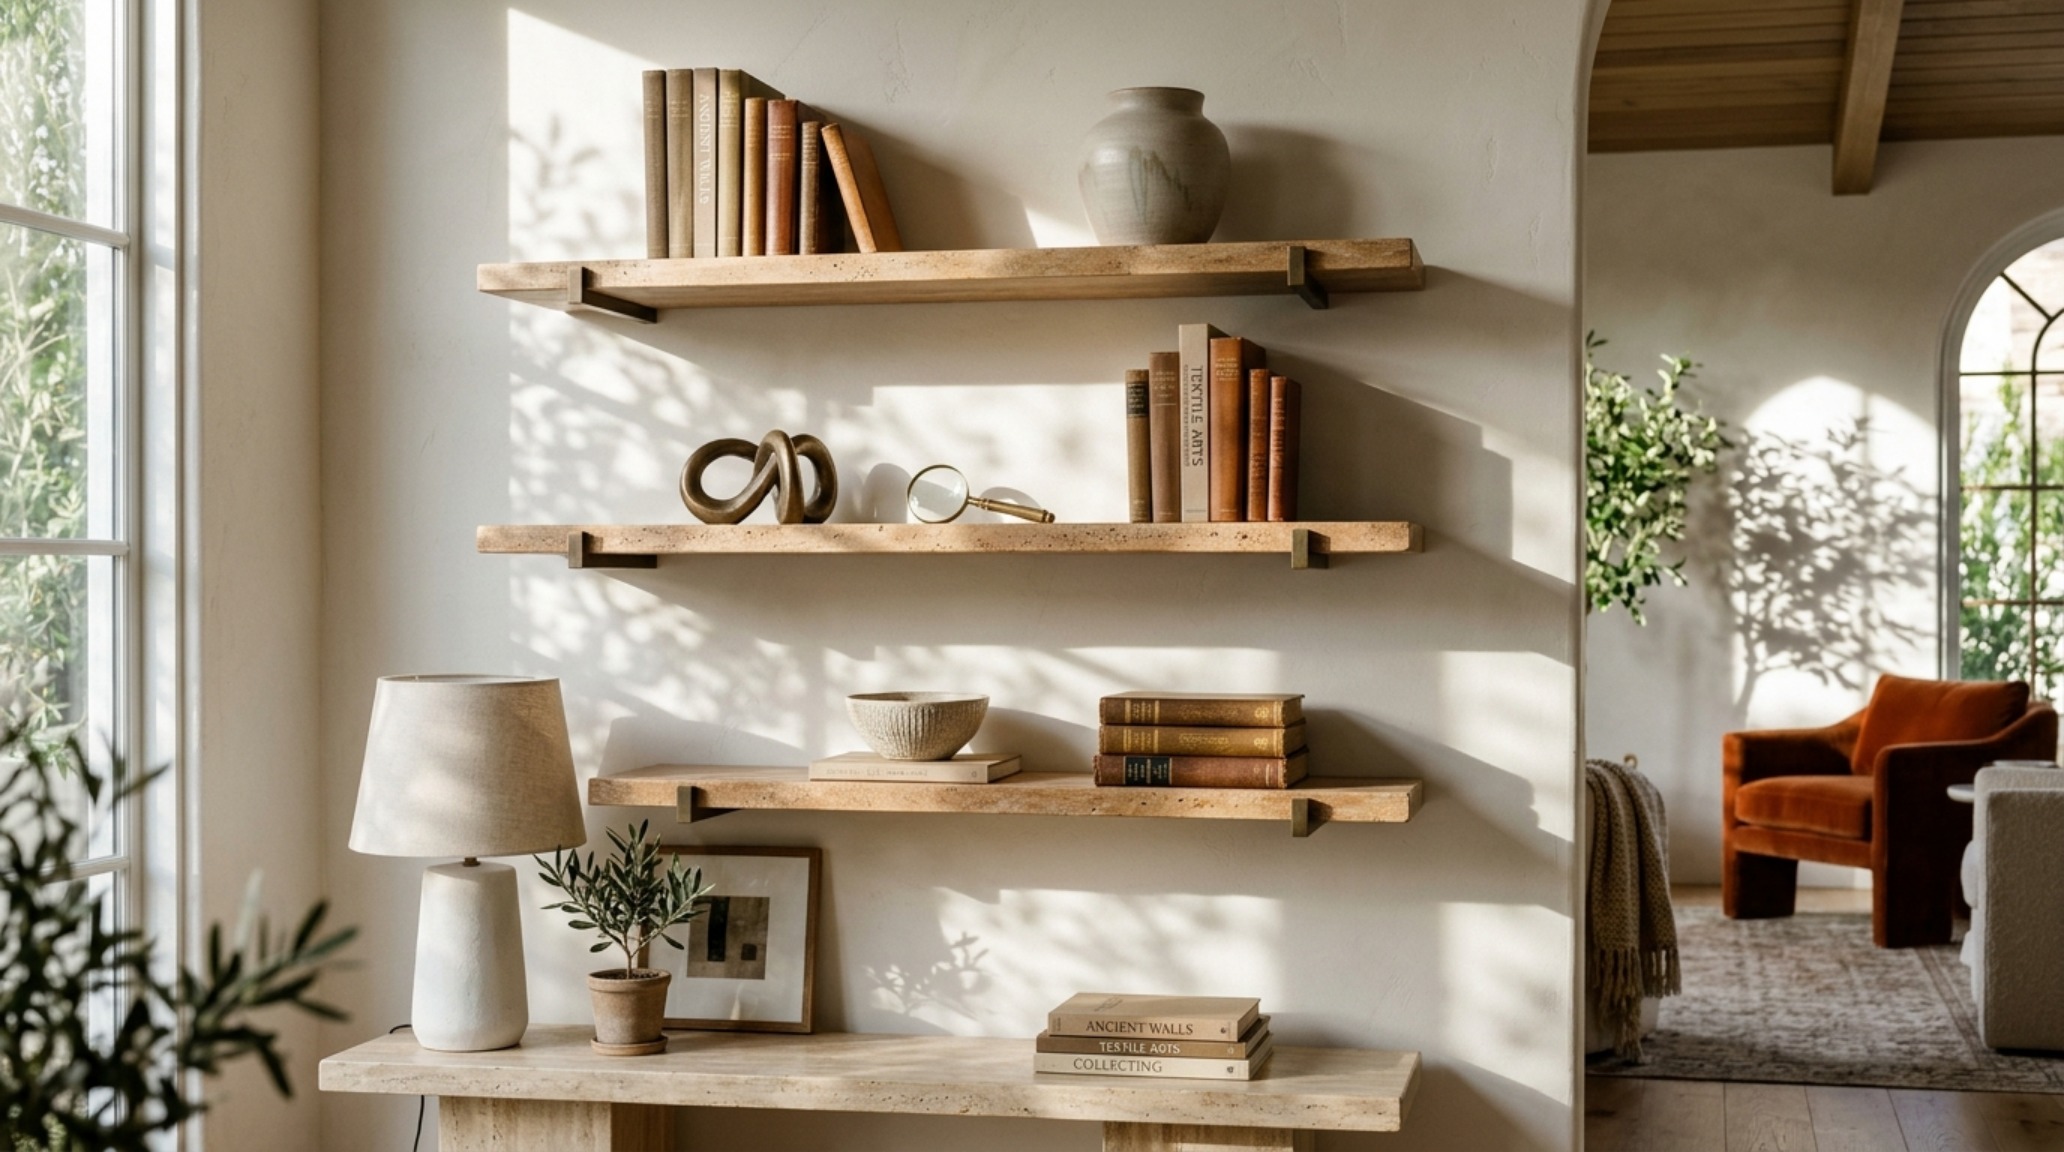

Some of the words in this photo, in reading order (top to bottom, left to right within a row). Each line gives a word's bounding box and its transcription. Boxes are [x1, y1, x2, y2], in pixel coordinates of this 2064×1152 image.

[1086, 1020, 1147, 1034] ANCIENT
[1149, 1022, 1194, 1036] WALLS
[1073, 1057, 1163, 1073] COLLECTING
